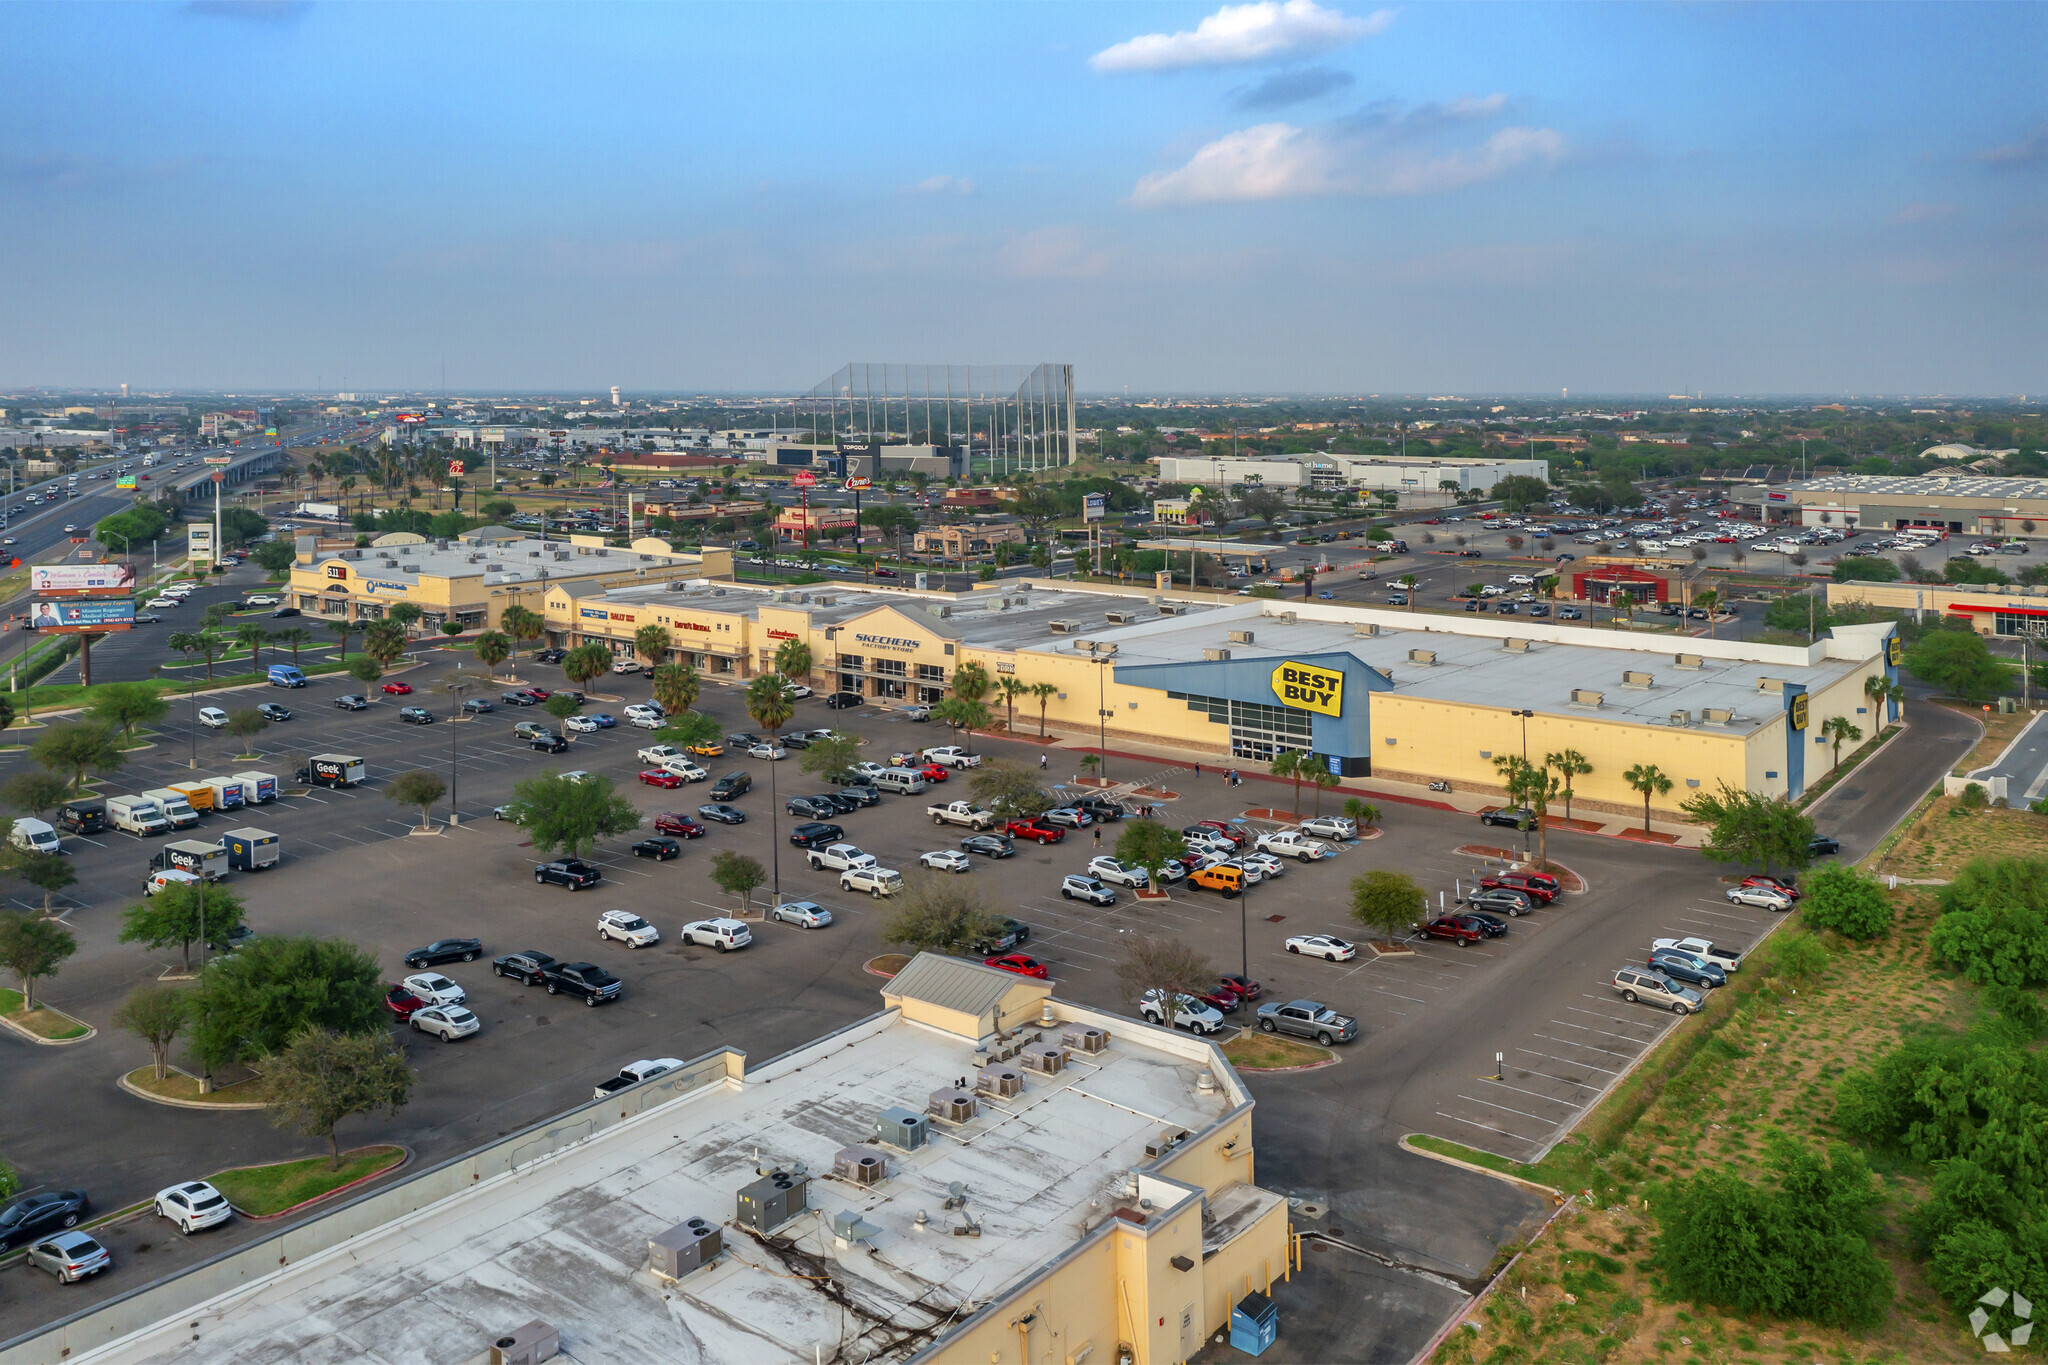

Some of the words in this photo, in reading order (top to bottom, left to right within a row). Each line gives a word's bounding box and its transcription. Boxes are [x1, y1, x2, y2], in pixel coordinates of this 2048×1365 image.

[1313, 460, 1333, 469] home
[845, 476, 872, 489] Cane's
[610, 612, 625, 621] SALLY
[854, 633, 921, 648] SKECHERS
[861, 642, 891, 651] FACTORY
[1283, 667, 1339, 692] BEST
[1284, 684, 1334, 707] BUY
[1795, 699, 1808, 713] BEST
[1796, 713, 1807, 725] BUY
[316, 762, 340, 774] Geek
[171, 852, 195, 866] Geek
